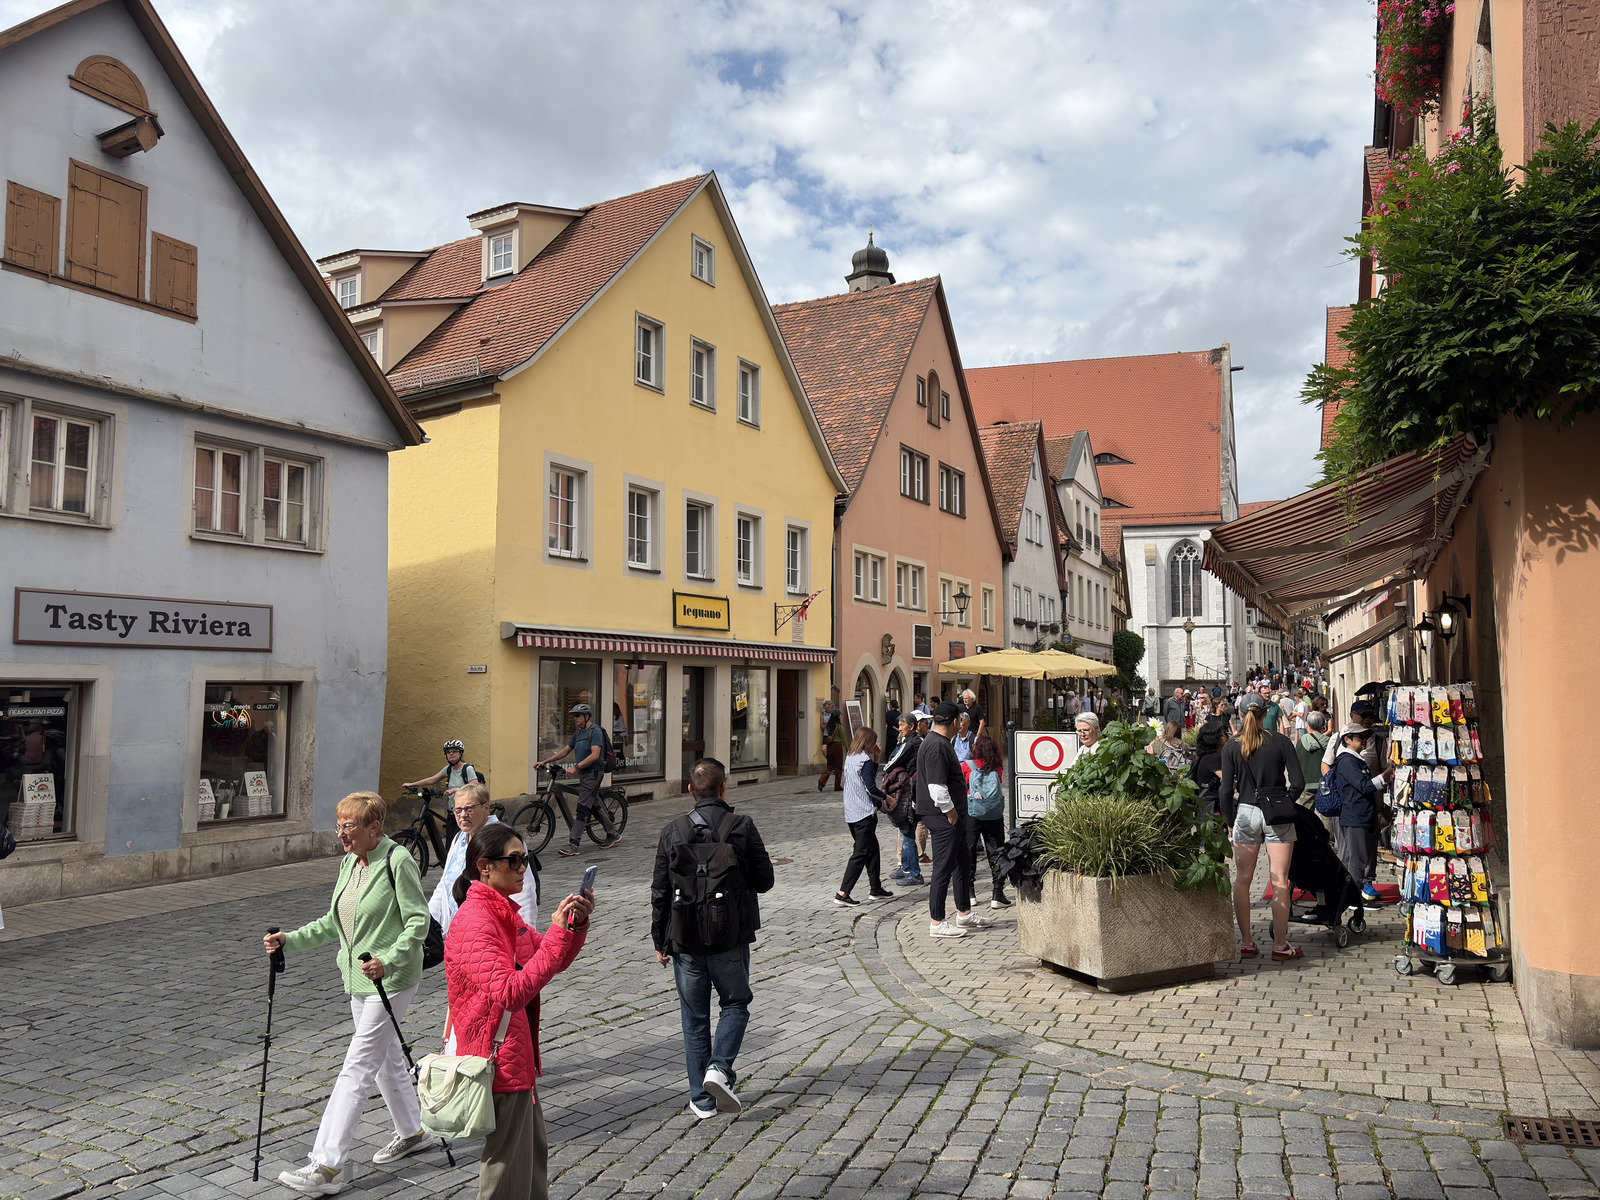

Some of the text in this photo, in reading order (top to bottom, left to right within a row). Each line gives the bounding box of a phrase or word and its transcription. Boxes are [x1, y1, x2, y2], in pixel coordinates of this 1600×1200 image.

[683, 604, 721, 619] leguano
[44, 604, 251, 638] Tasty Riviera
[615, 757, 625, 767] Der
[1023, 794, 1045, 802] 19-6h
